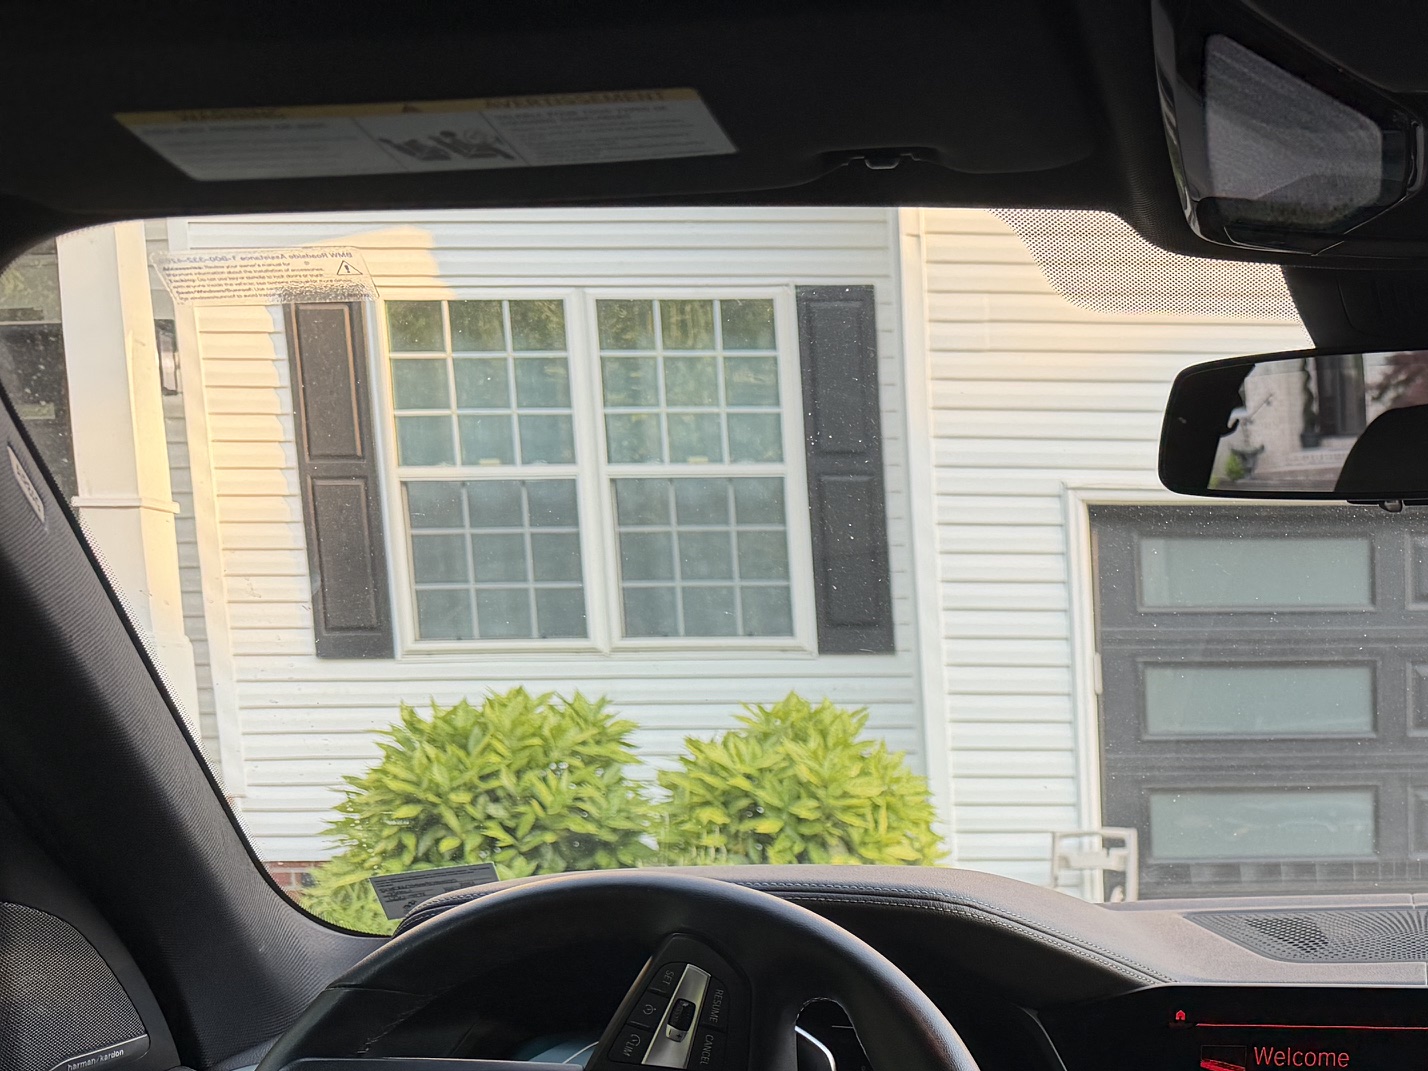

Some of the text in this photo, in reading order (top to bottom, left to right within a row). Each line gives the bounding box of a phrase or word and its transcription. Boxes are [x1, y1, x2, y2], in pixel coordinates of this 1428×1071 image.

[662, 969, 675, 986] SET
[709, 988, 725, 1024] RESUME
[623, 1042, 635, 1058] LIM
[700, 1034, 715, 1066] CANCEL
[1253, 1046, 1350, 1067] Welcome
